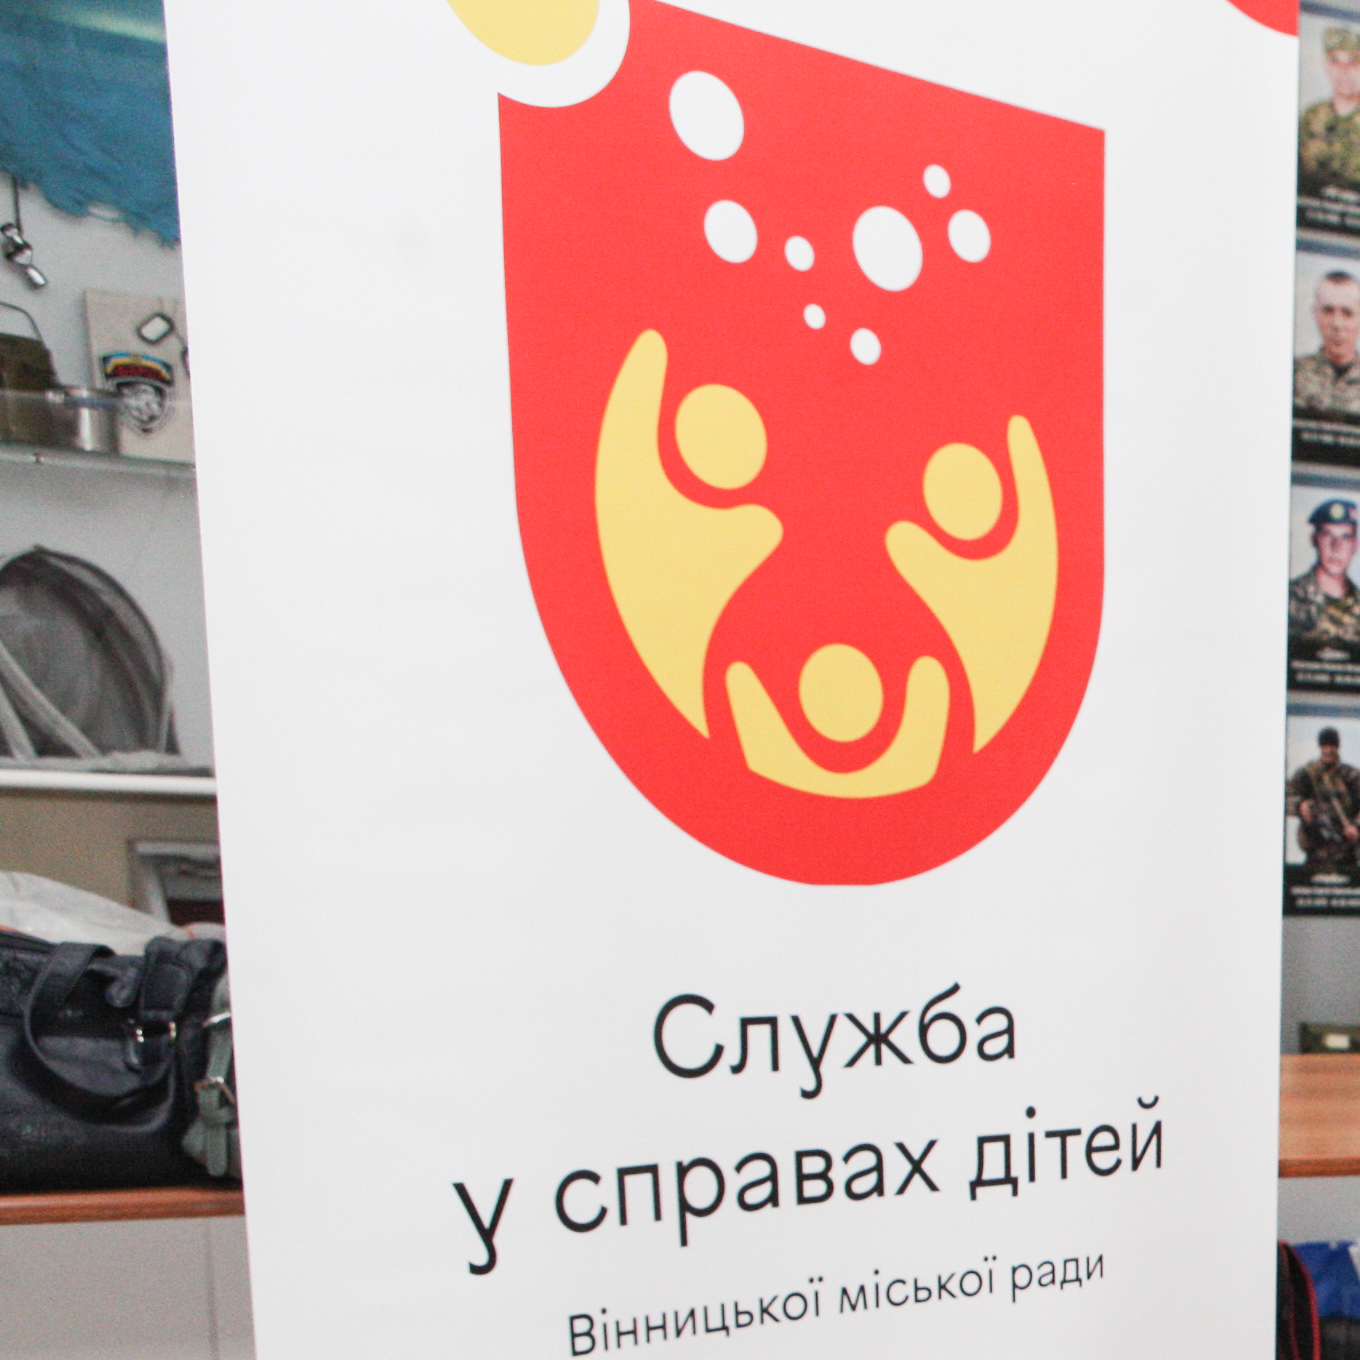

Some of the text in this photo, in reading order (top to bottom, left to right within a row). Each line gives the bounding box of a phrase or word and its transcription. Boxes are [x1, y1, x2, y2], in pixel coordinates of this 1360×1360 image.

[652, 981, 1016, 1100] Служба
[452, 1094, 1164, 1276] у справах дітей
[568, 1253, 1105, 1358] Вінницької міської ради
